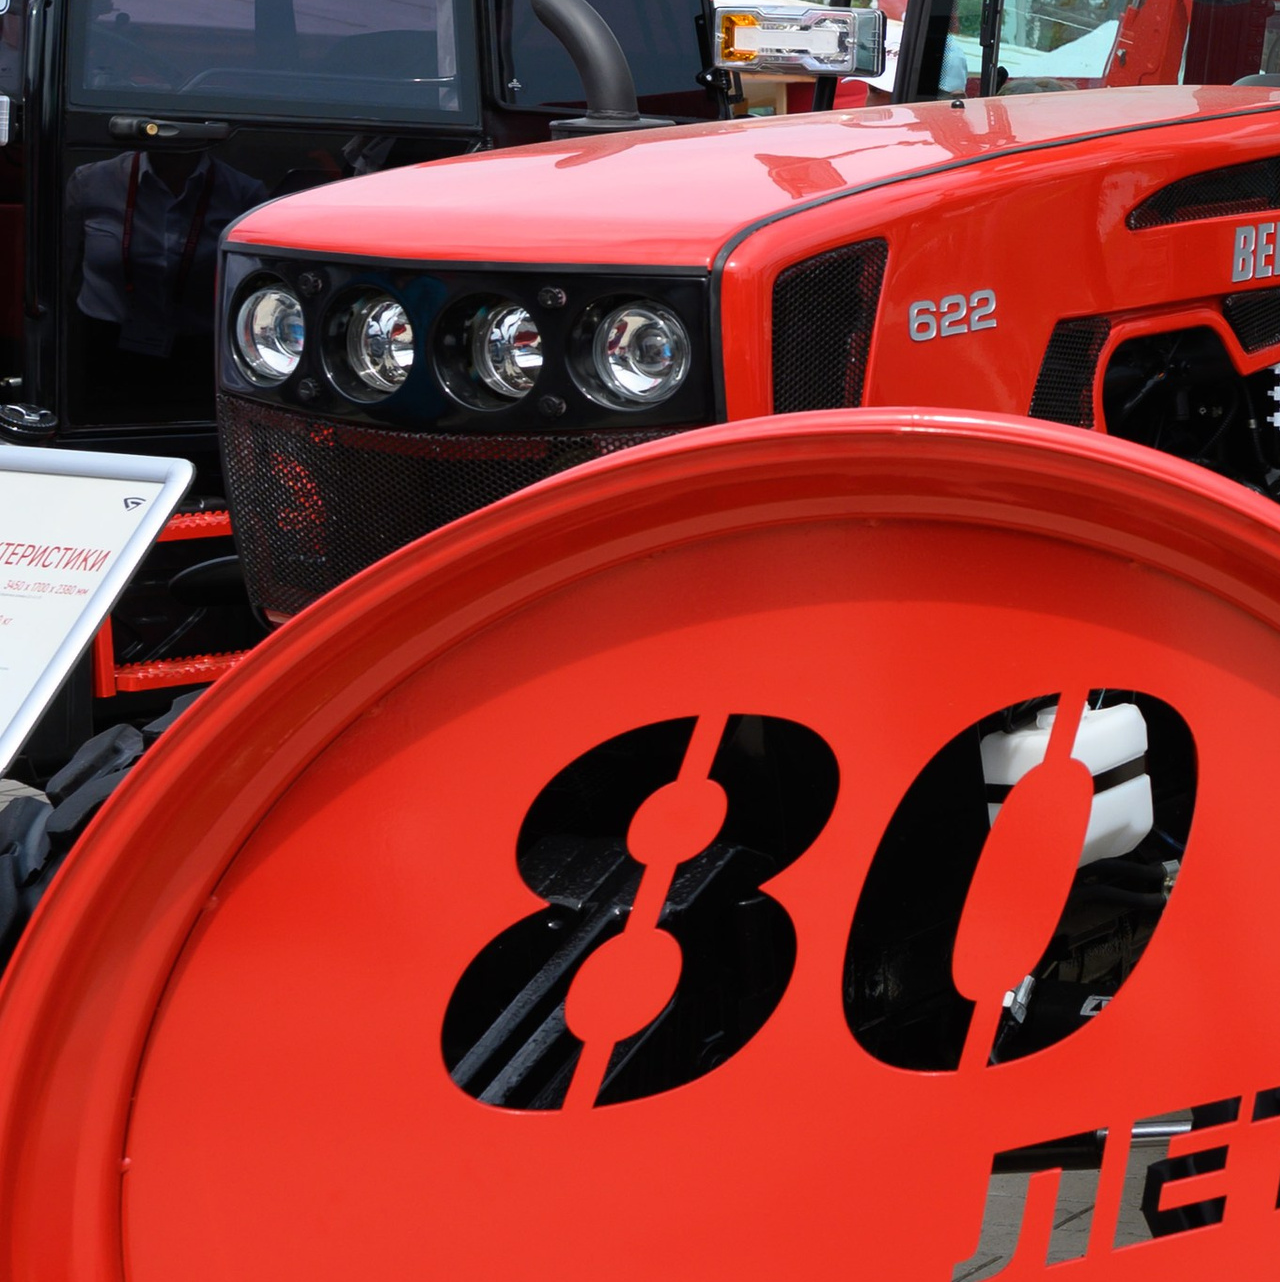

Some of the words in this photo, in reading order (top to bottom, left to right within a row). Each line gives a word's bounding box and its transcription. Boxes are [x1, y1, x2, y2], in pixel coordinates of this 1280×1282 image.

[908, 289, 998, 343] 622
[0, 542, 111, 572] ТЕРИСТИКИ
[440, 688, 1199, 1115] 80
